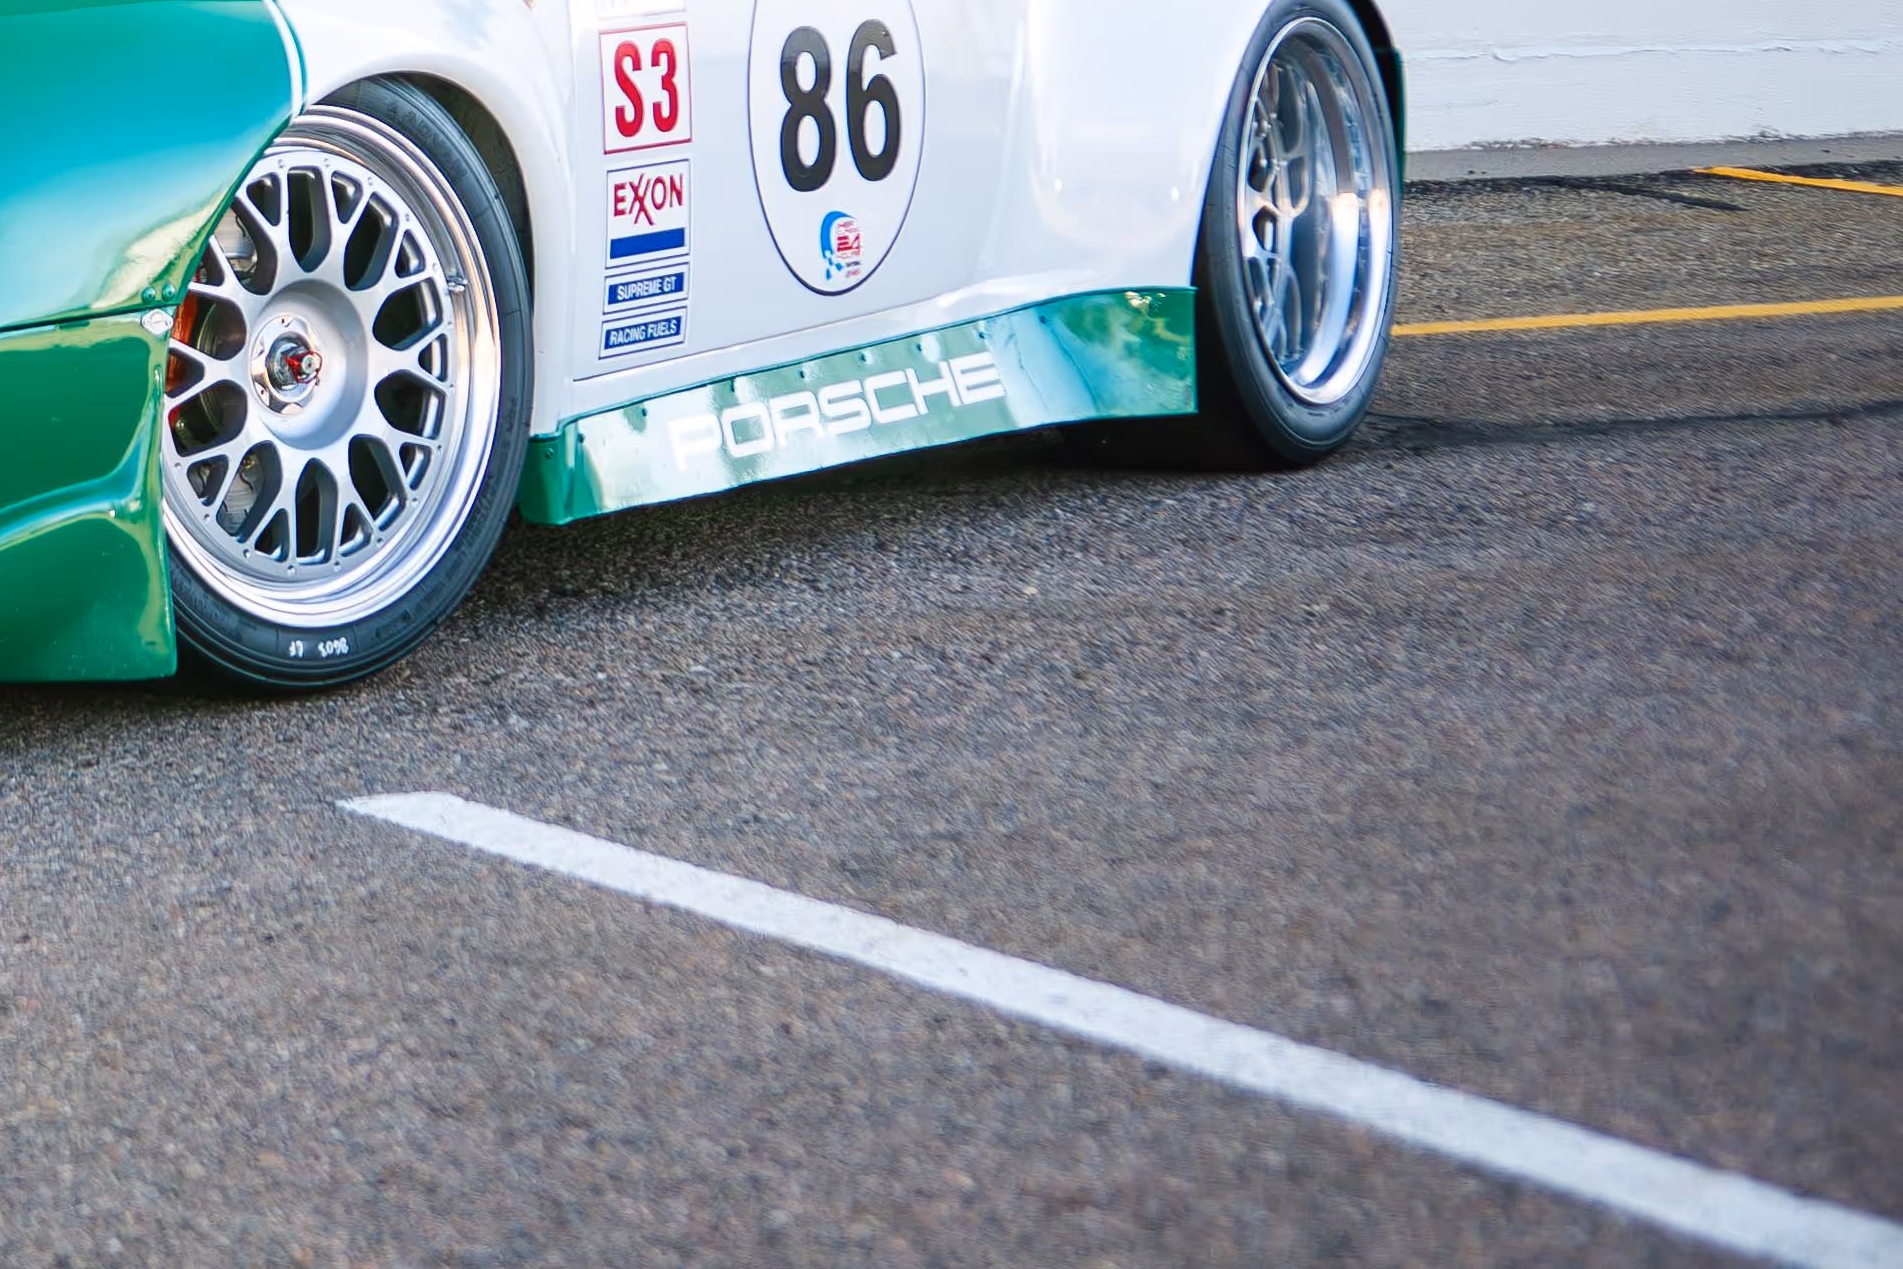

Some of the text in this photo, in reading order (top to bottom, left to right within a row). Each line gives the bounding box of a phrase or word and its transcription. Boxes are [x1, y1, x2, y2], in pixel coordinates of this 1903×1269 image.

[613, 38, 679, 138] S3
[779, 19, 902, 192] 86
[613, 173, 684, 226] EXXON
[616, 276, 677, 301] SUPREME GT
[608, 319, 678, 346] RACING FUELS
[665, 350, 1009, 472] PORSCHE
